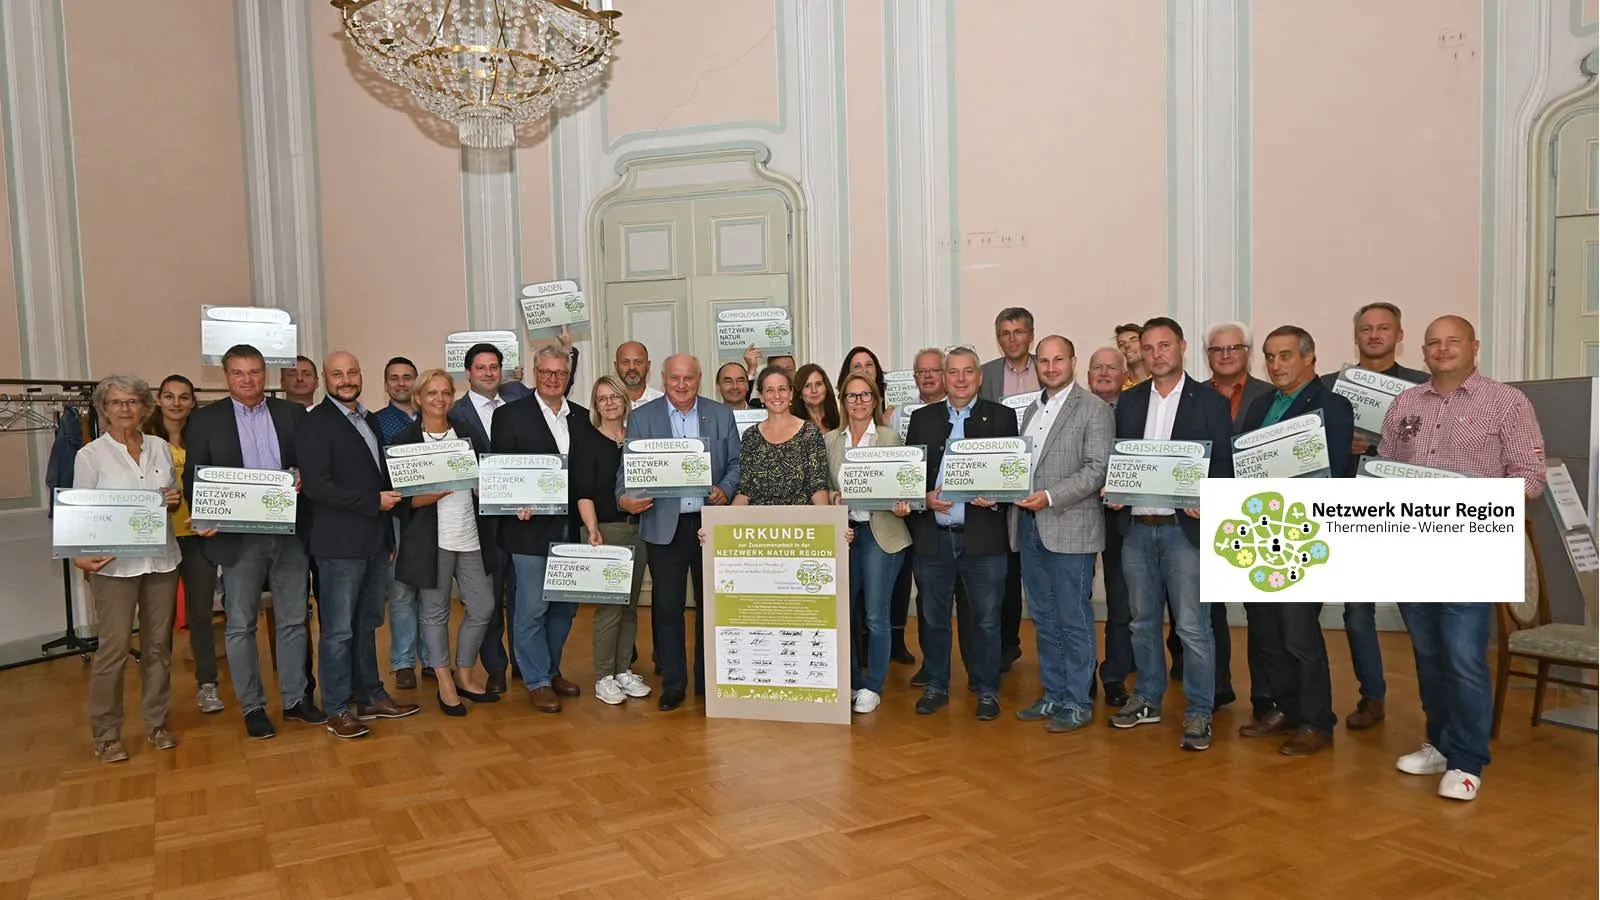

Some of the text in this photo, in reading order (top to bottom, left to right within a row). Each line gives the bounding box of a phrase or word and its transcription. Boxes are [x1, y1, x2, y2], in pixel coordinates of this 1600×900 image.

[538, 284, 562, 293] BADEN
[525, 303, 555, 311] NETZWERK
[1353, 371, 1376, 384] BAD
[1335, 388, 1381, 408] NETZWERK
[957, 441, 1019, 450] MOOSBRUNN
[1120, 443, 1201, 453] TRAISKIRCHEN
[847, 451, 920, 459] OBERWALTERSDORF
[1236, 449, 1279, 467] NETZWERK
[390, 461, 434, 470] NETZWERK
[1110, 463, 1158, 471] NETZWERK
[1236, 464, 1262, 477] NATUR
[204, 470, 288, 481] EBREICHSDORF
[393, 474, 425, 483] REGION
[1108, 480, 1142, 488] REGION
[196, 490, 247, 498] NETZWERK
[733, 528, 816, 540] URKUNDE
